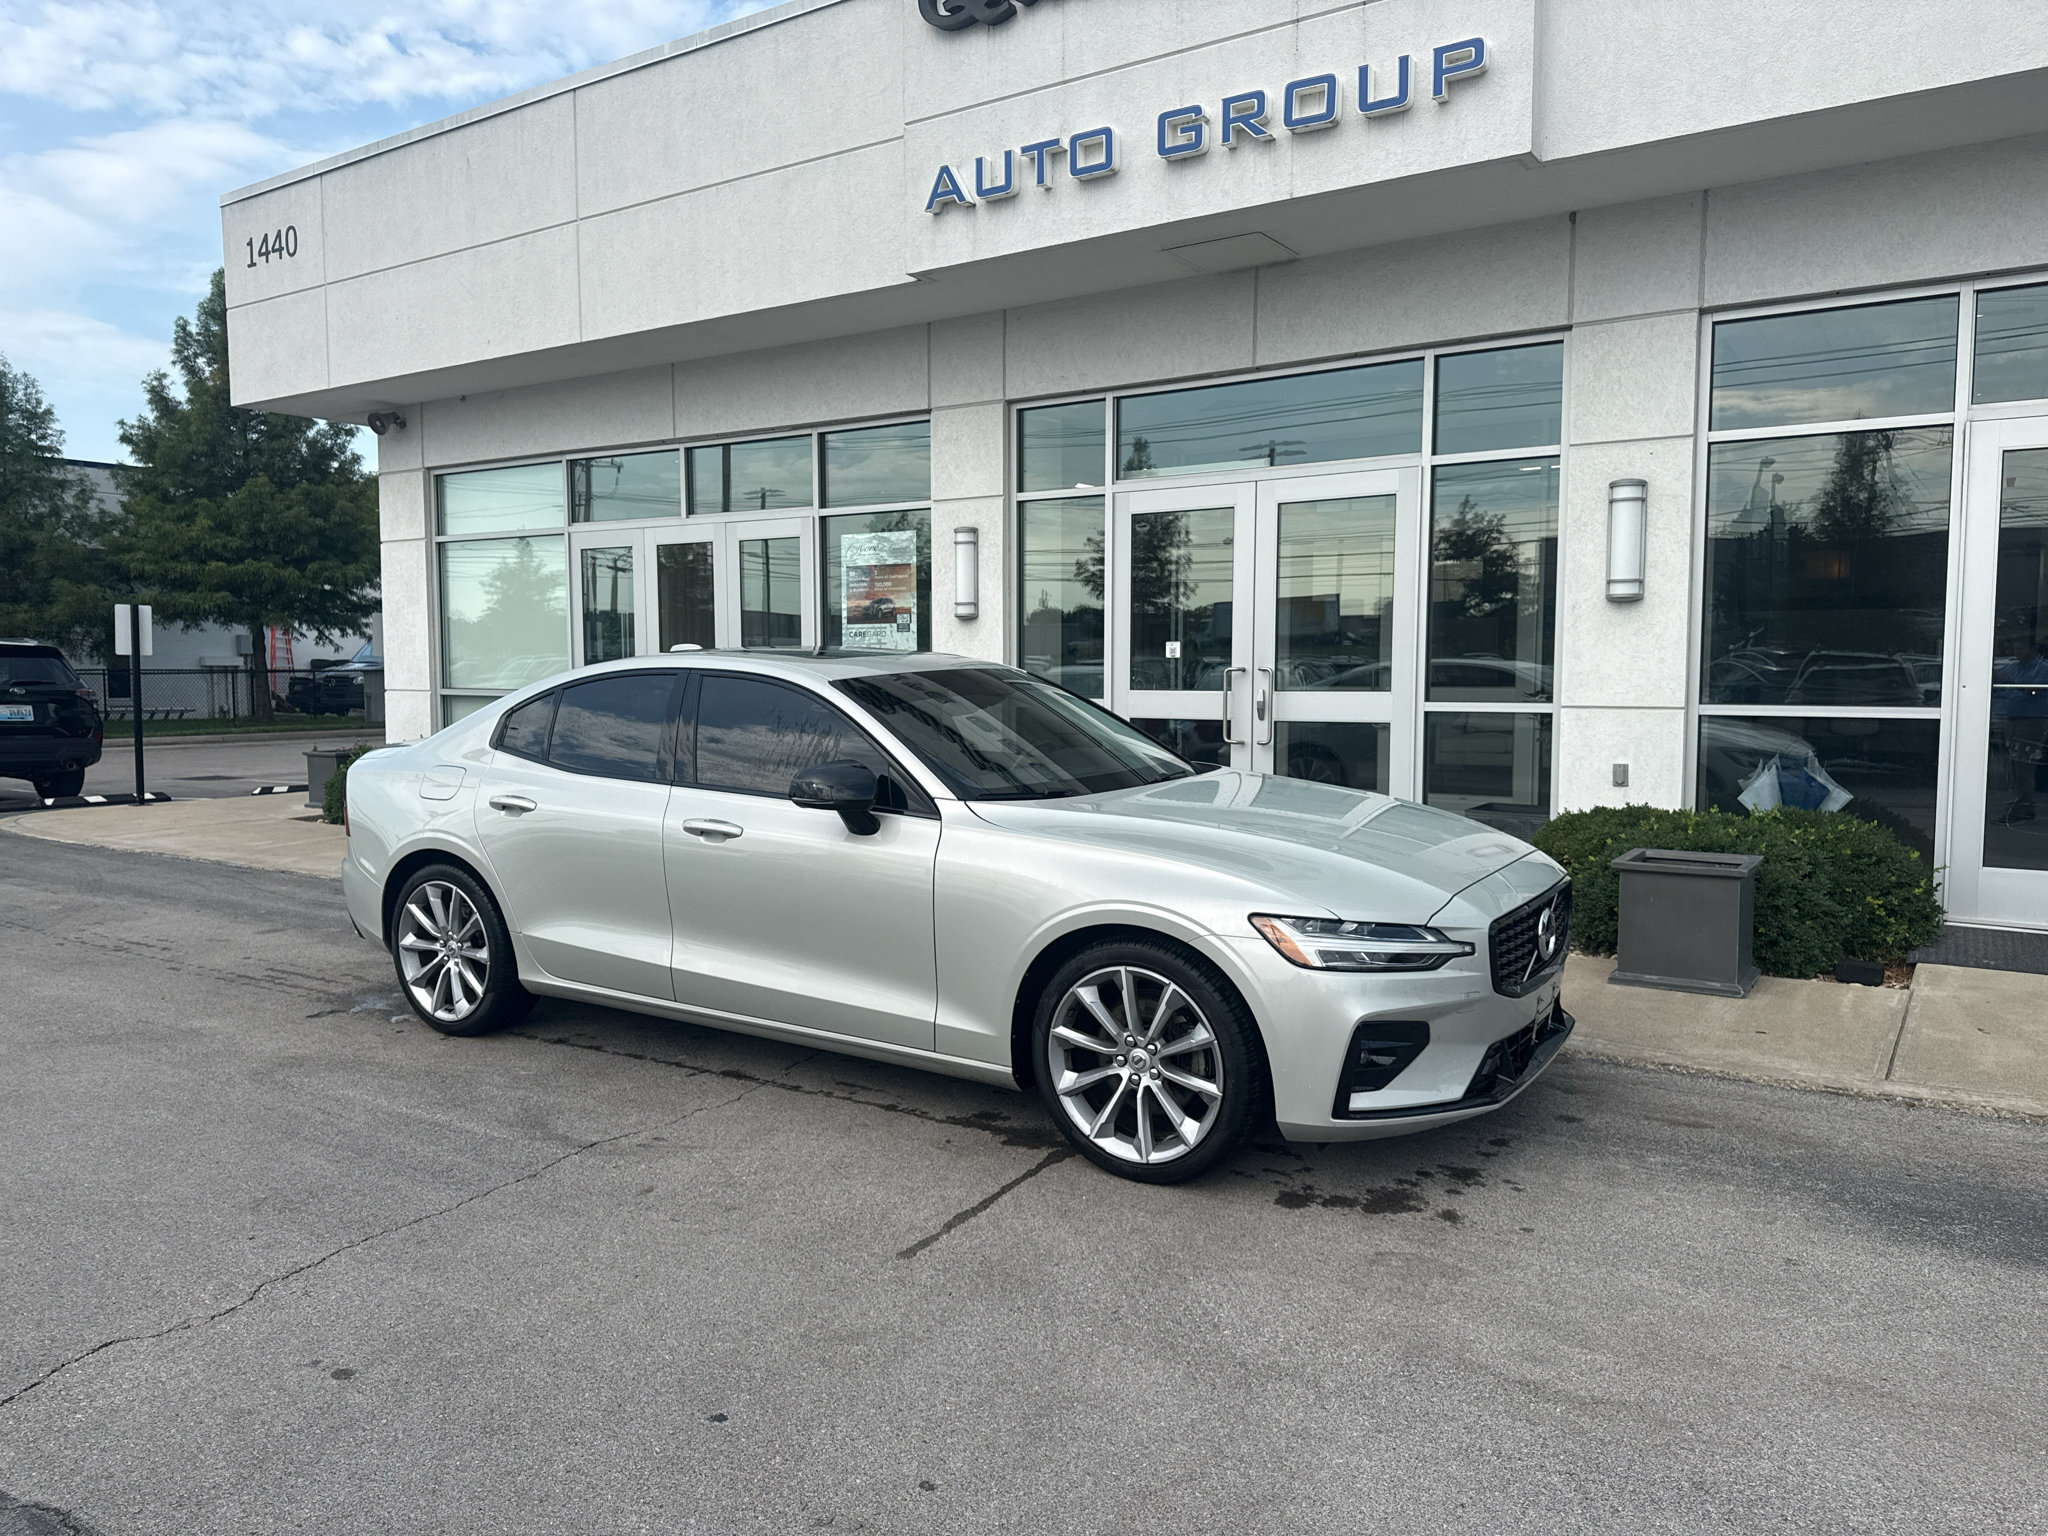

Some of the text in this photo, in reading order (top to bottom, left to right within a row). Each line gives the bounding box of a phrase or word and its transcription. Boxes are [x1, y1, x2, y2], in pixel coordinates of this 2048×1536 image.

[925, 37, 1486, 213] AUTO GROUP
[246, 225, 298, 268] 1440
[848, 630, 887, 638] CAREGARD
